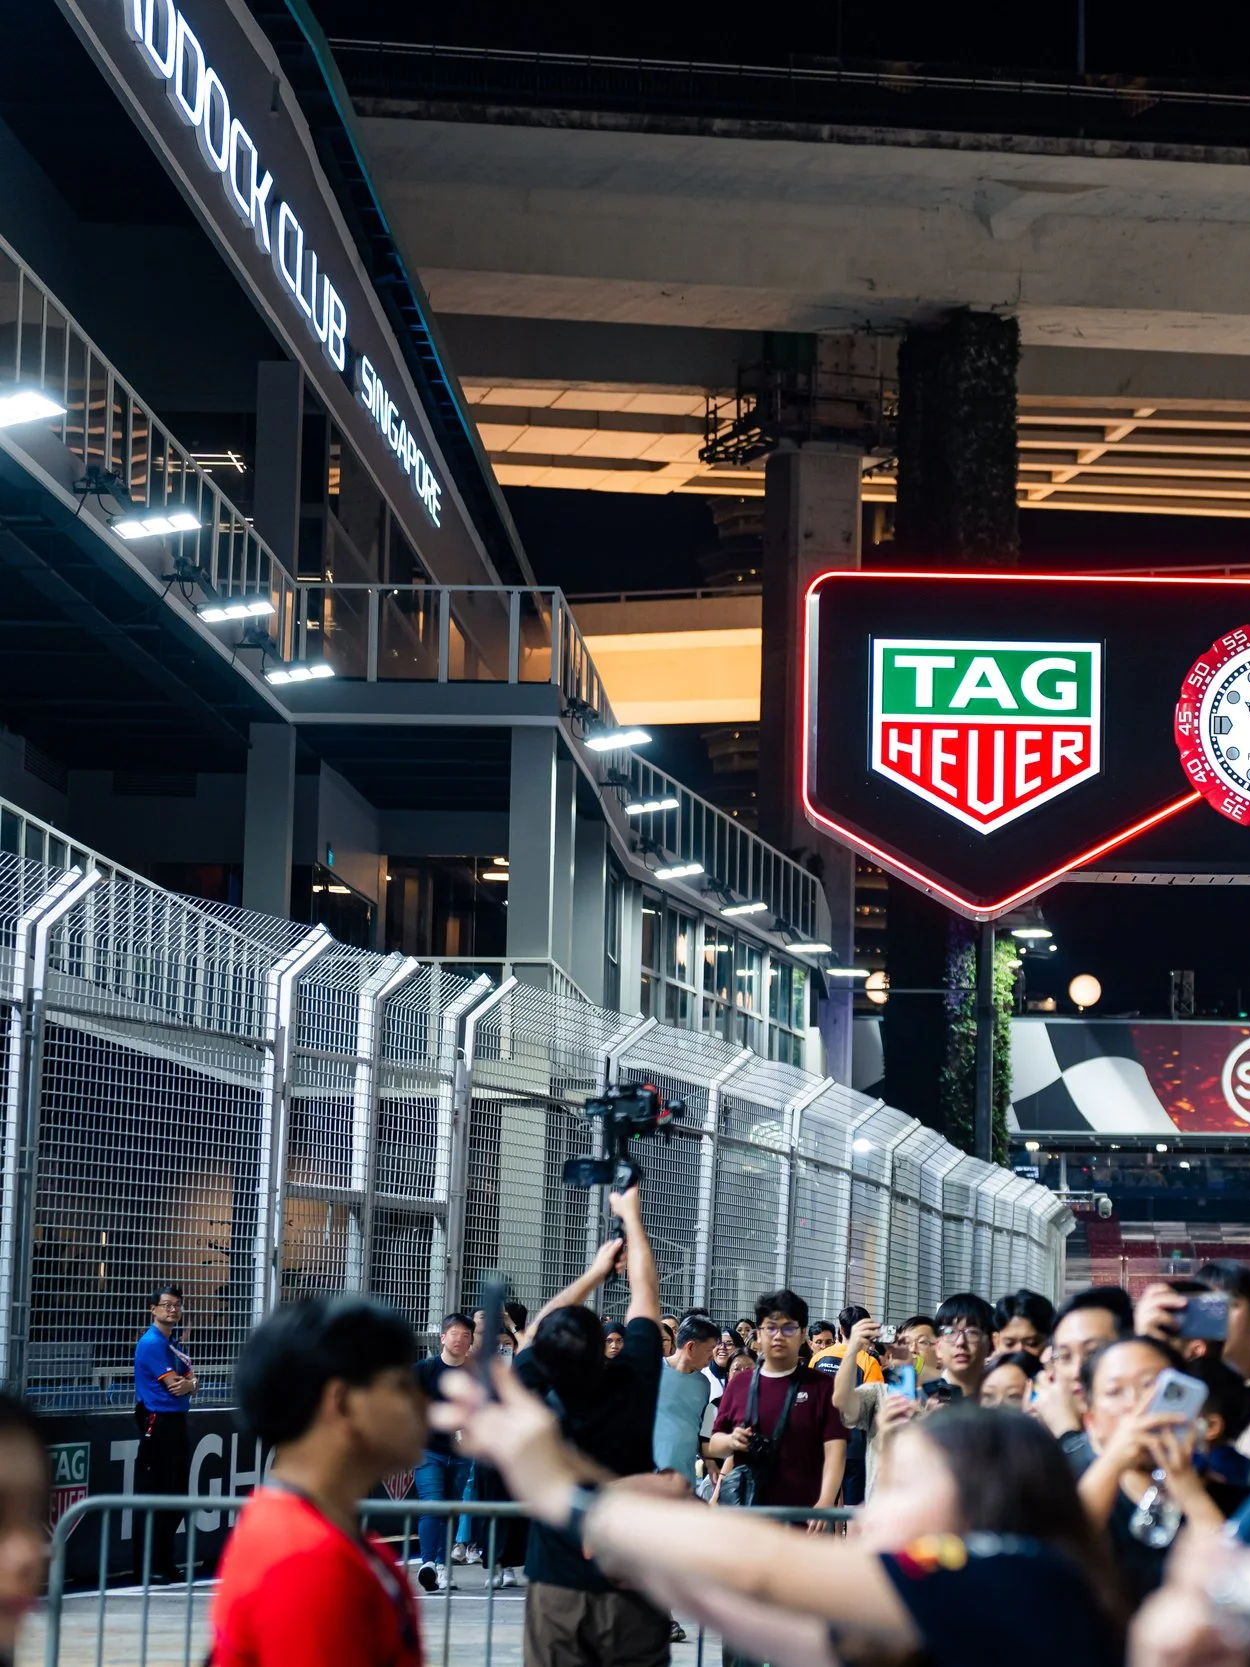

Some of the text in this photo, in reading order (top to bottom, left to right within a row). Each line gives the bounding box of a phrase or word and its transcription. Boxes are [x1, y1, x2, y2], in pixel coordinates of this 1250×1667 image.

[278, 201, 347, 372] CLUB
[361, 355, 441, 528] SINGAPORE
[1222, 630, 1248, 650] 55
[894, 655, 1078, 710] TAG
[1188, 662, 1210, 688] 50
[1178, 711, 1192, 736] 45
[889, 728, 1084, 815] HEUER
[1187, 758, 1207, 783] 40
[1221, 798, 1246, 819] 35
